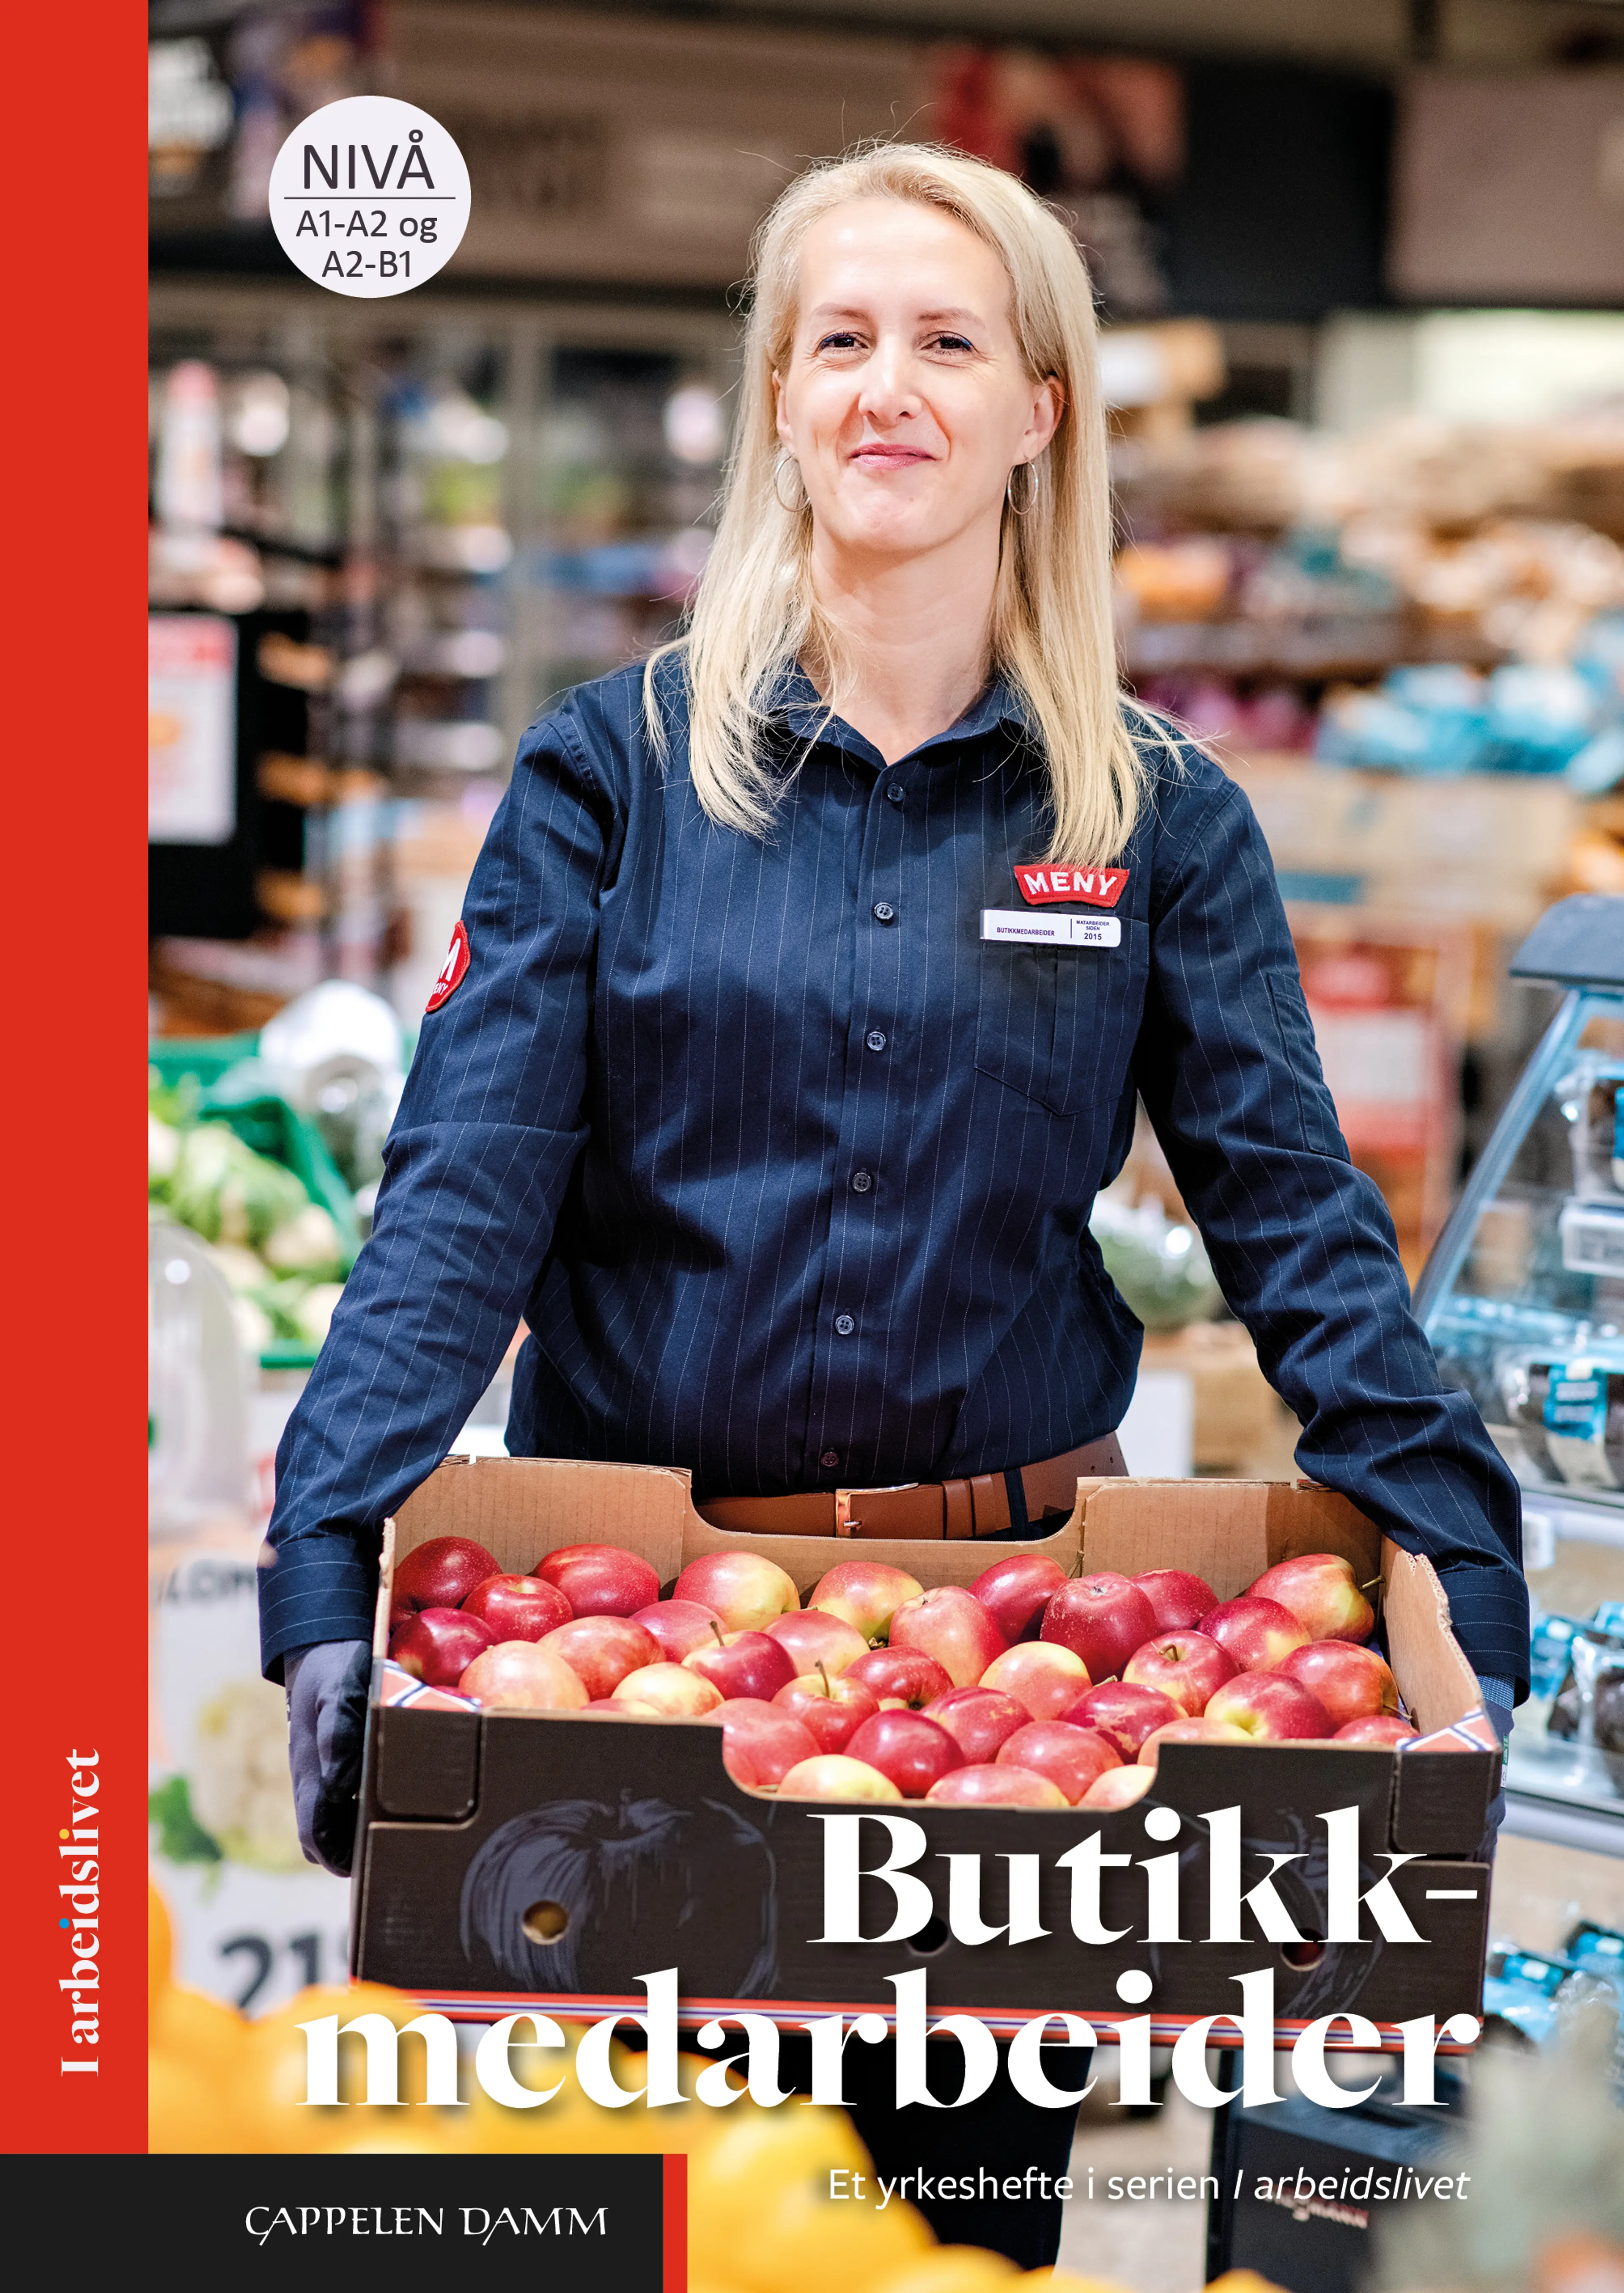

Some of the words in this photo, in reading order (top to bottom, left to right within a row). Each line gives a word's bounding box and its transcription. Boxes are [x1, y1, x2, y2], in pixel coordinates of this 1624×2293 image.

[1023, 871, 1117, 896] MENY
[996, 927, 1055, 936] BUTIKKMEDARBEIDER
[1084, 932, 1103, 941] 2015
[433, 982, 449, 996] ENY
